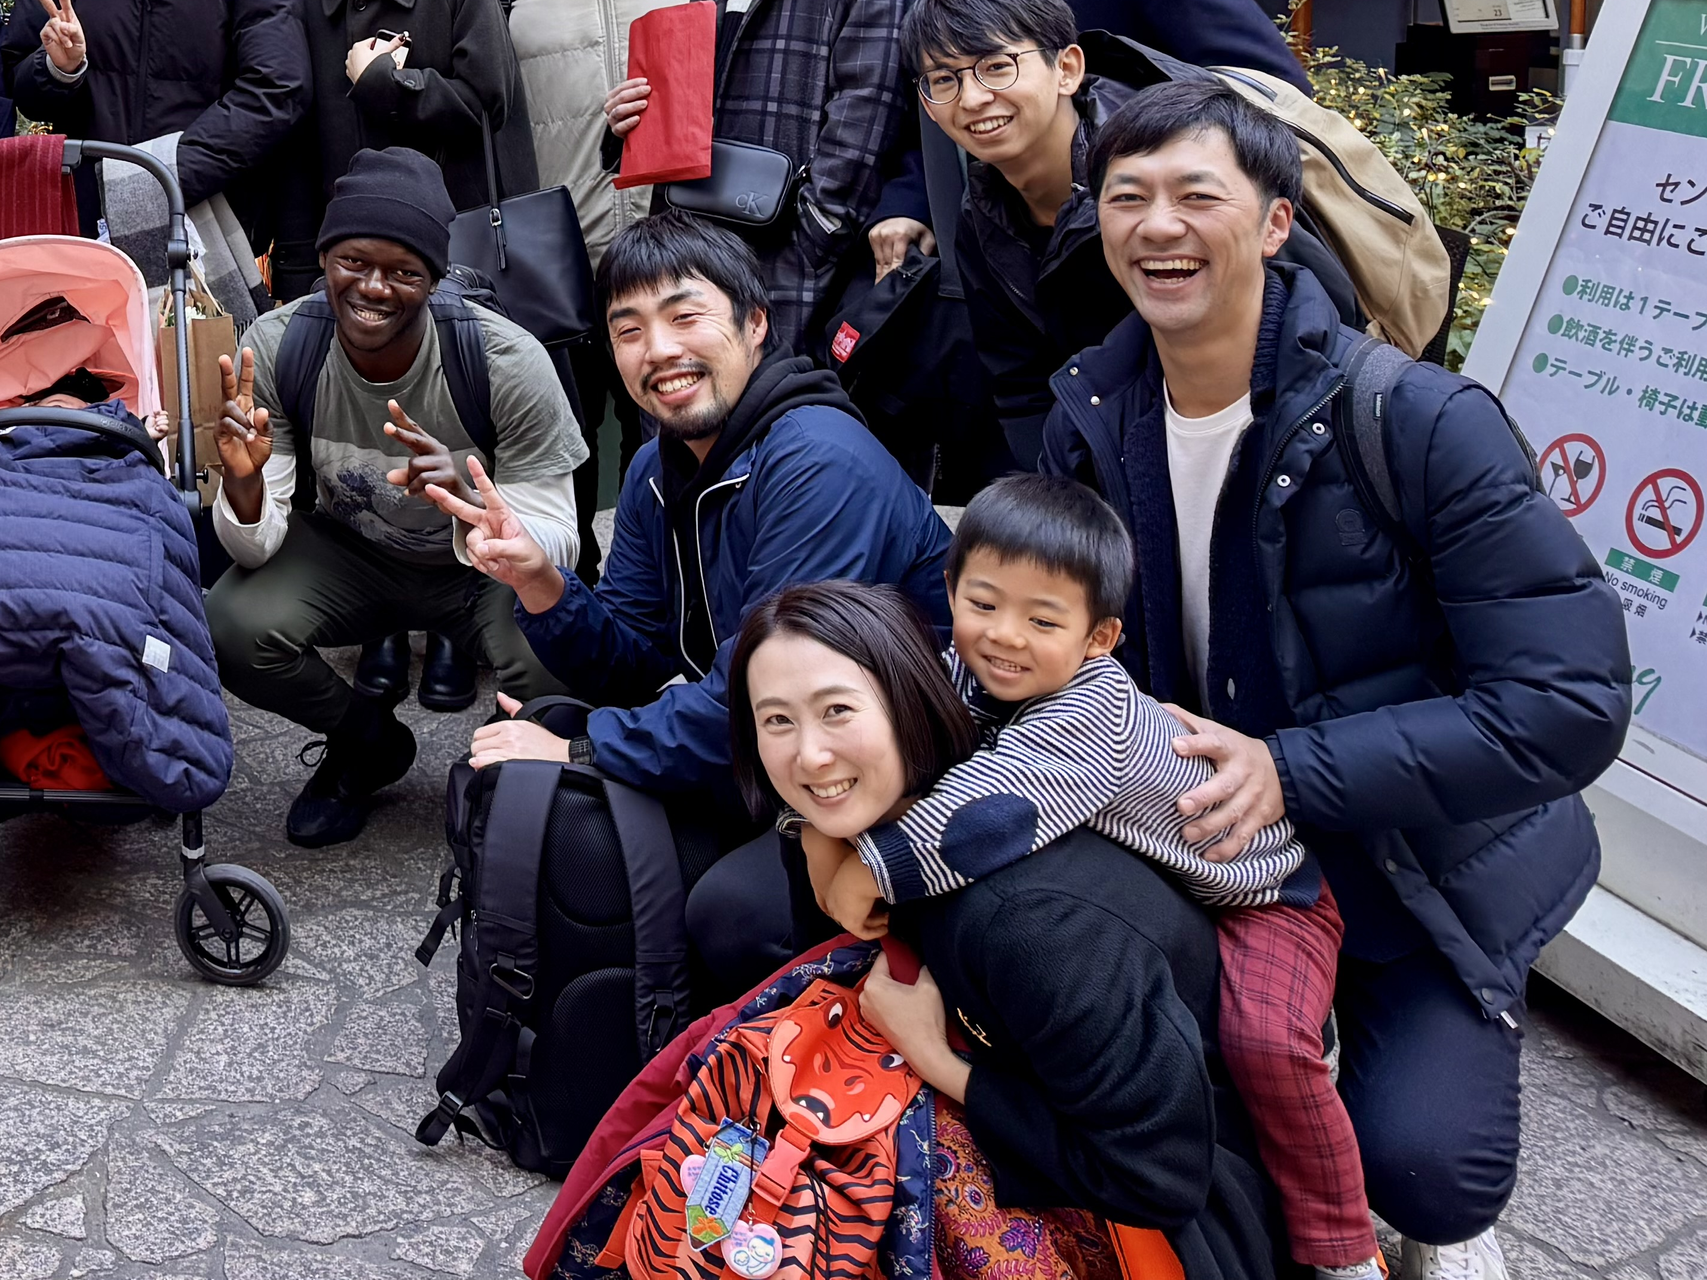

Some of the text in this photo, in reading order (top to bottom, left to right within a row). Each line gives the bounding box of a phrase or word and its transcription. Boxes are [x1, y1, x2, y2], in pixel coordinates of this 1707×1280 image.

[1604, 571, 1668, 610] No smoking
[704, 1164, 740, 1216] Chitose
